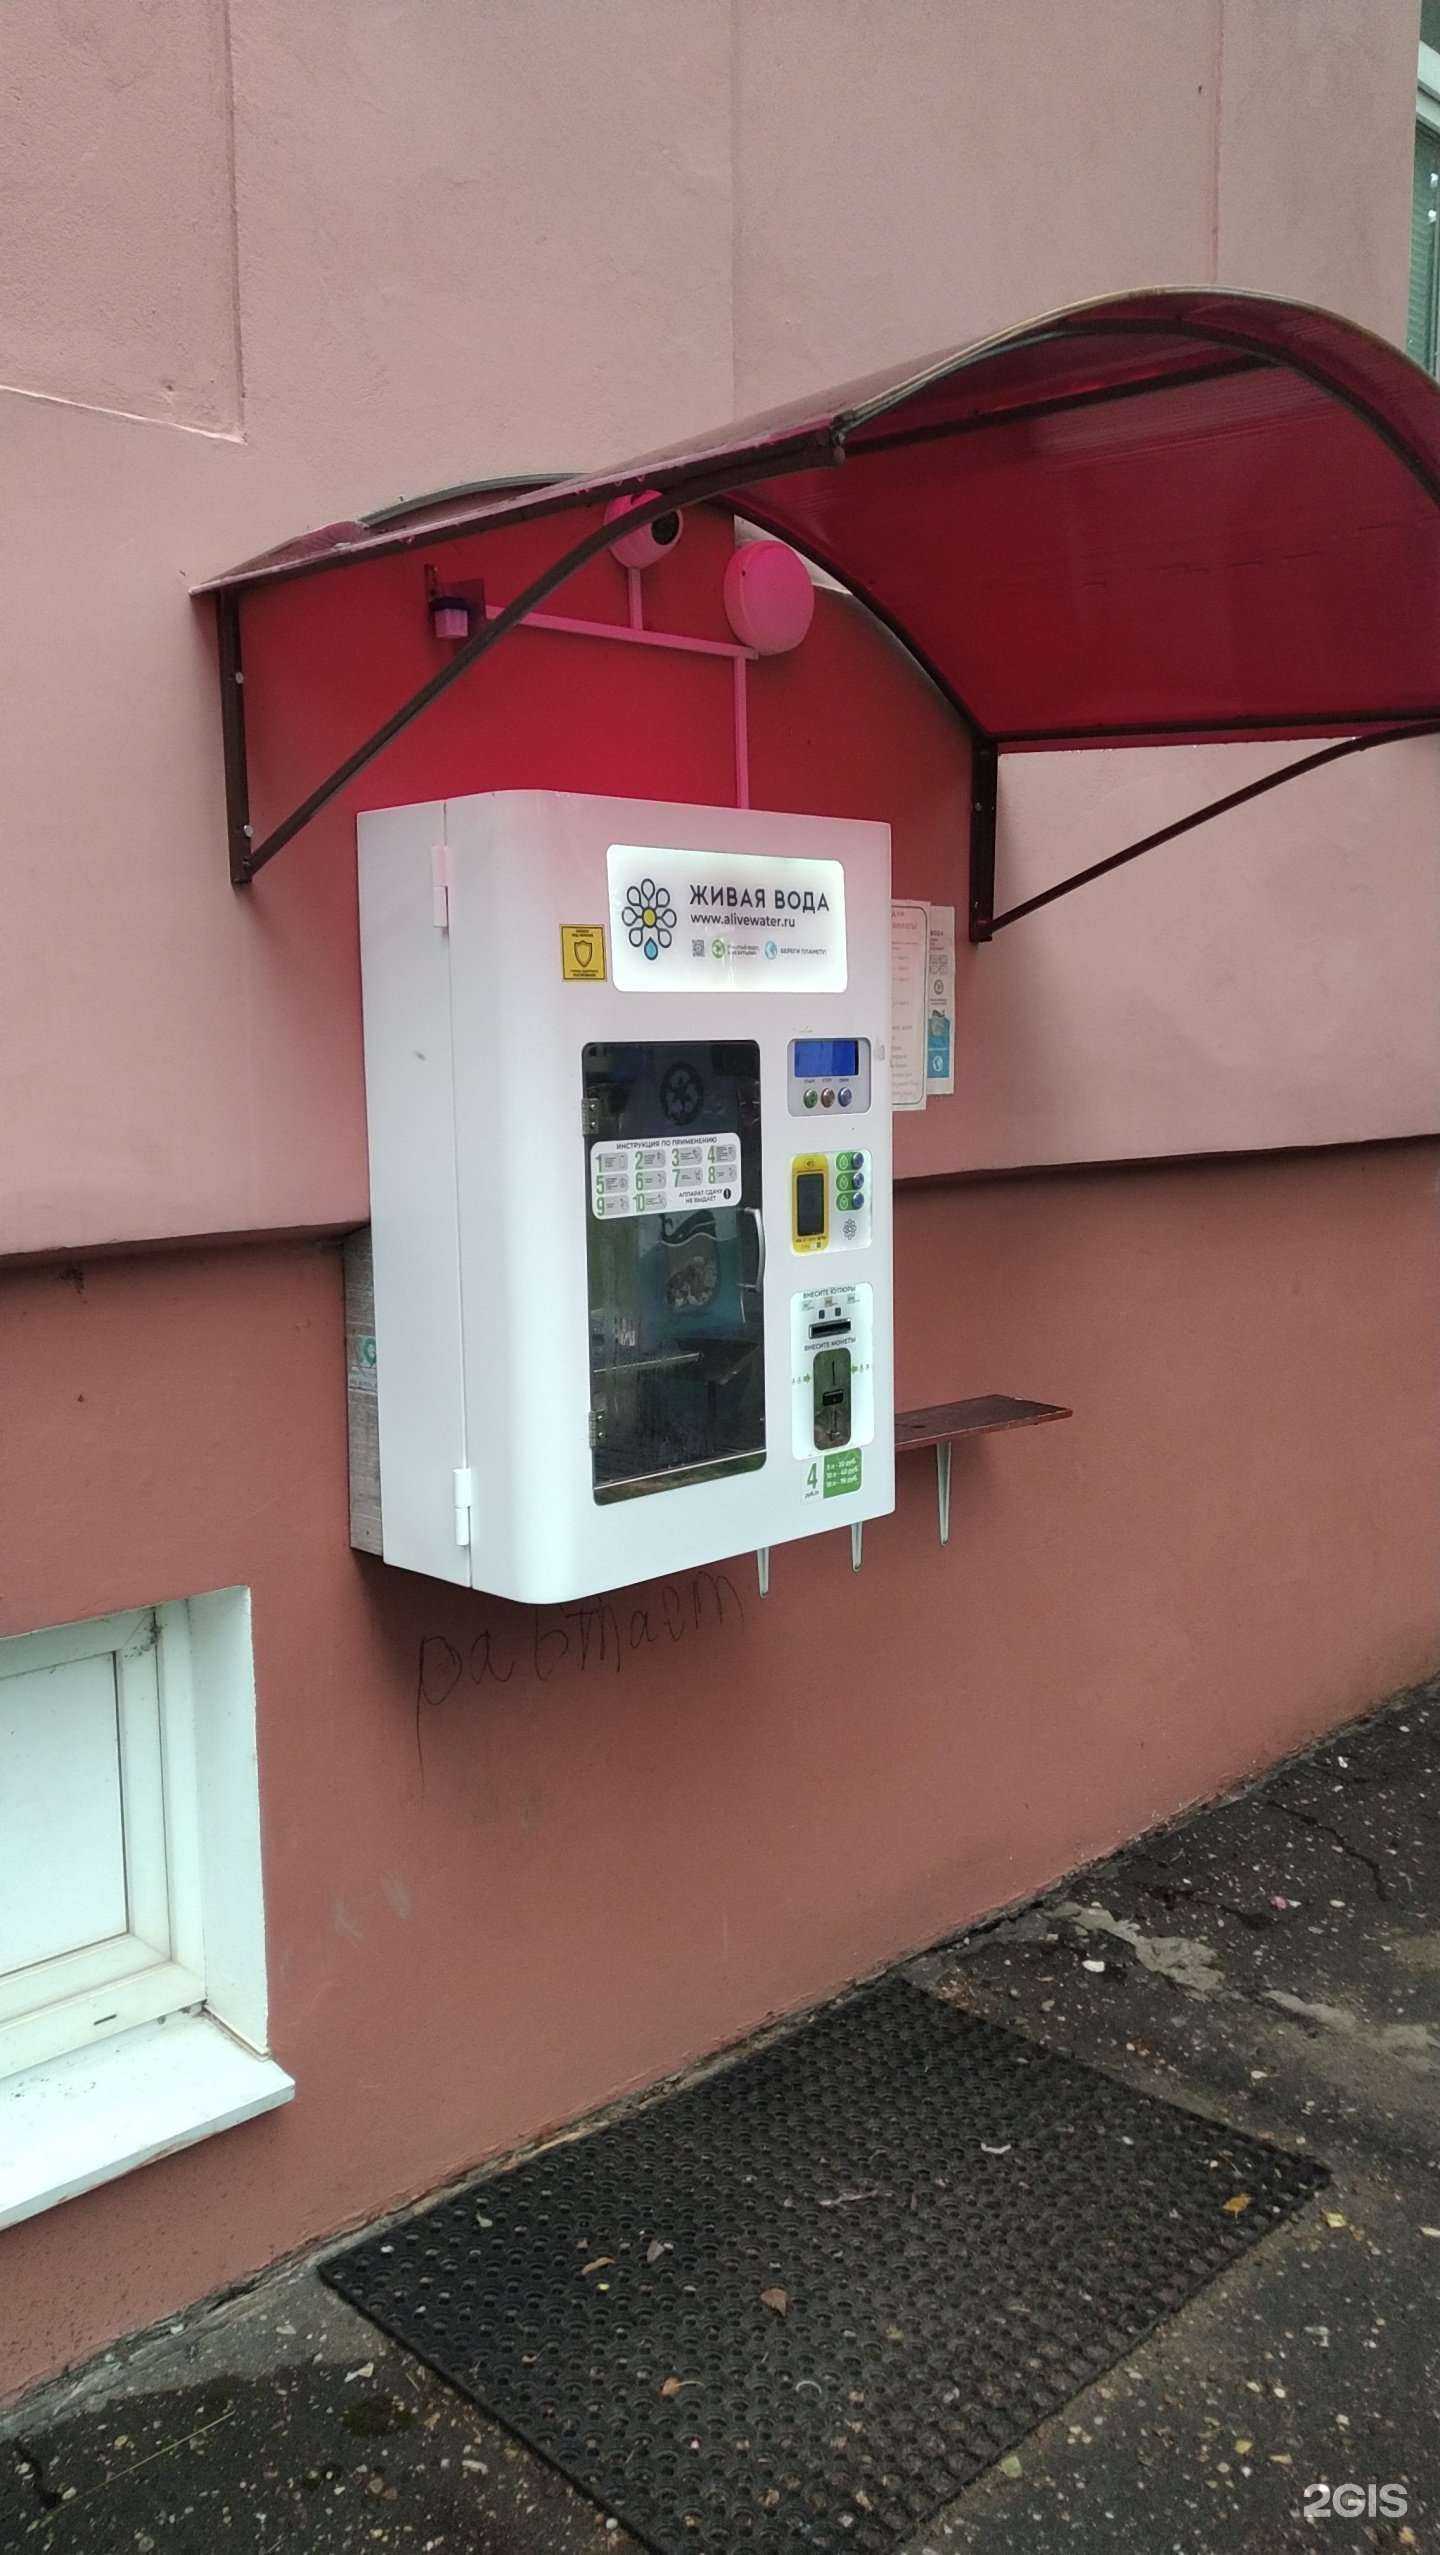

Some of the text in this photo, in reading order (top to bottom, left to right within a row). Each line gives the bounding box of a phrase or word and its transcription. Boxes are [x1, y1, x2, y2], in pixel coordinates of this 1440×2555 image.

[690, 884, 829, 914] ЖИВАЯ ВОДА
[690, 912, 796, 928] www.alivewater.ru
[616, 1140, 659, 1150] ИНСТРУКЦИЯ
[672, 1137, 718, 1146] ПРИМЕНЕНИЮ
[595, 1154, 602, 1173] 1
[635, 1151, 643, 1170] 2
[672, 1148, 680, 1167] 3
[707, 1145, 715, 1163] 4
[596, 1175, 604, 1194] 5
[635, 1172, 644, 1191] 6
[672, 1169, 681, 1187] 7
[708, 1166, 716, 1184] 8
[596, 1197, 605, 1216] 9
[632, 1193, 645, 1212] 10
[807, 1462, 818, 1489] 4
